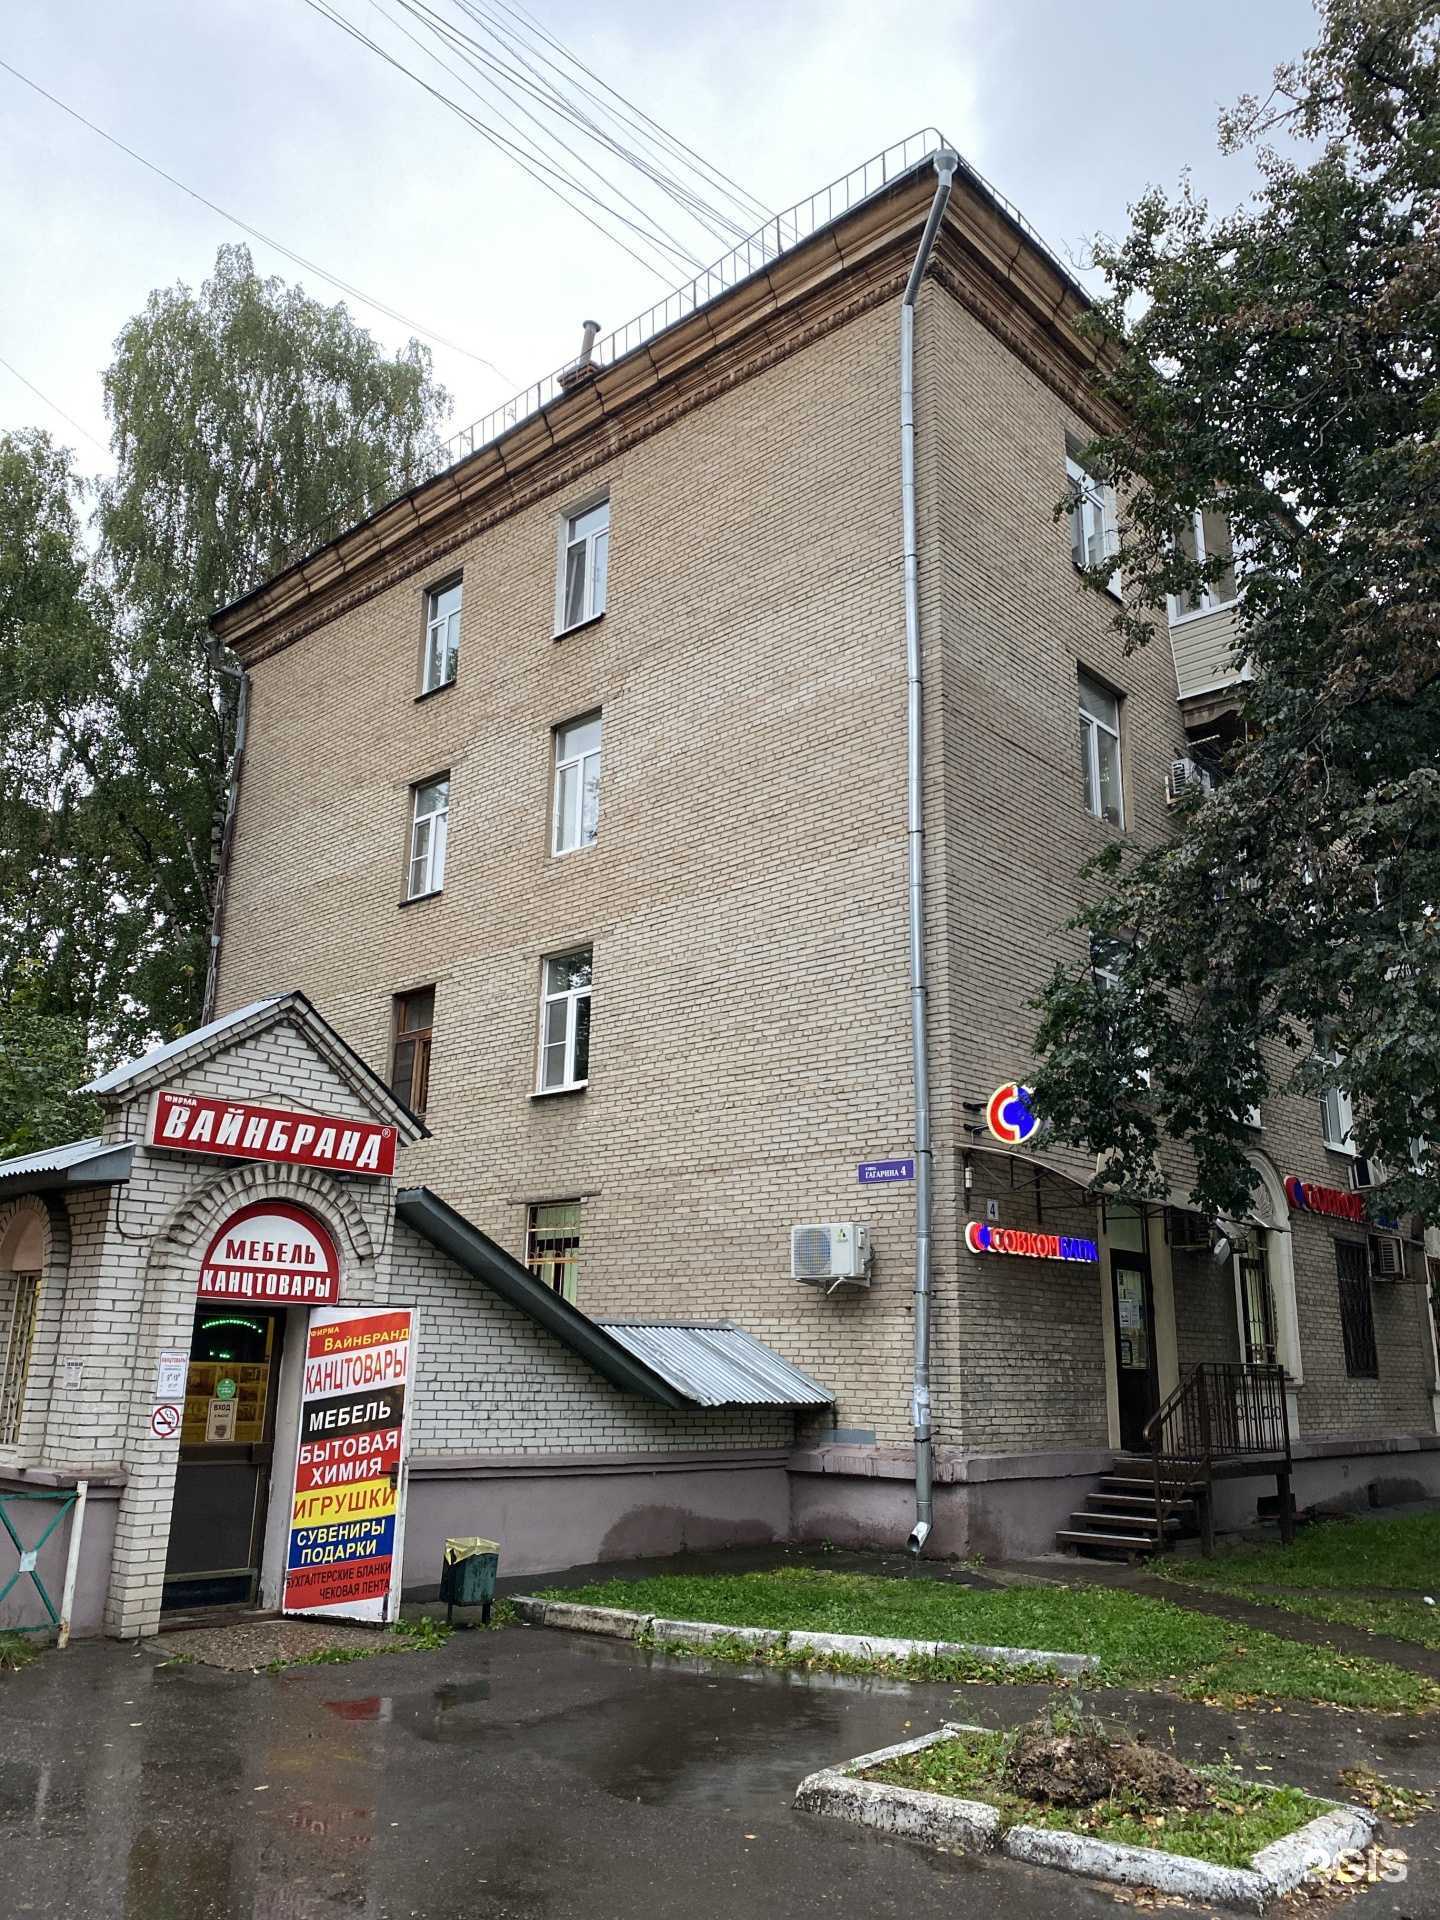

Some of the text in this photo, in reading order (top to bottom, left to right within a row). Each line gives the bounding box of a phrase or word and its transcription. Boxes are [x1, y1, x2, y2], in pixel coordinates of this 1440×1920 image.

[164, 1095, 198, 1106] ФИРМА
[162, 1105, 382, 1169] ВАЙНБРАНД
[865, 1165, 907, 1179] ГАГАРИНА 4
[989, 1202, 996, 1216] 4
[225, 1239, 316, 1265] МЕБЕЛЬ
[201, 1269, 331, 1298] КАНЦТОВАРЫ
[310, 1326, 340, 1337] ФИРМА
[304, 1346, 408, 1395] КАНЦТОВАРЫ
[308, 1401, 391, 1432] МЕБЕЛЬ
[299, 1430, 398, 1465] БЫТОВАЯ
[310, 1457, 382, 1486] ХИМИЯ
[293, 1486, 396, 1520] ИГРУШКИ
[297, 1519, 386, 1546] СУВЕНИРЫ
[301, 1539, 377, 1564] ПОДАРКИ
[286, 1562, 392, 1588] БУХГАЛТЕРСКИЕ БЛАНКИ
[320, 1578, 390, 1601] ЧЕКОВАЯ ЛЕНТА
